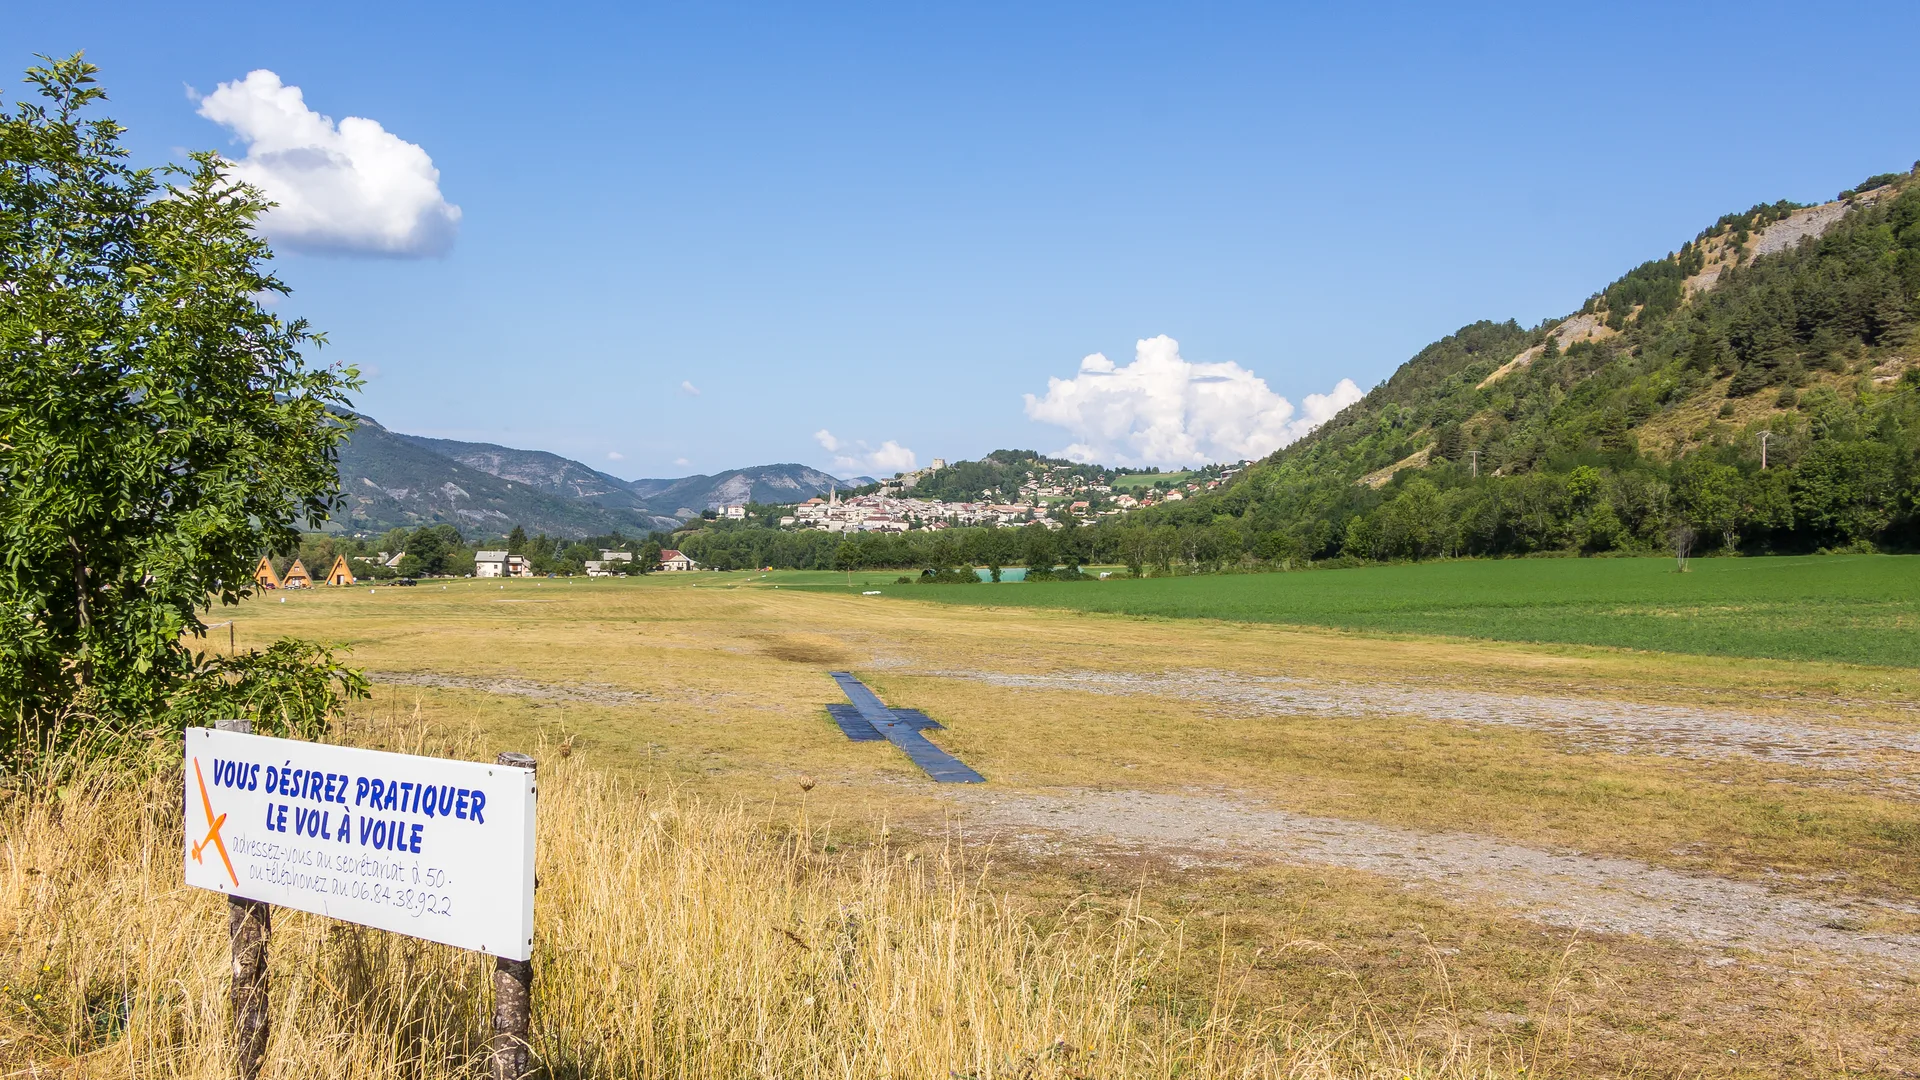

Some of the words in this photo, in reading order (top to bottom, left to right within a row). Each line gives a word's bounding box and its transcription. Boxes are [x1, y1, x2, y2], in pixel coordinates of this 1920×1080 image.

[214, 758, 260, 791] VOUS
[265, 760, 349, 804] DÉSIREZ
[355, 776, 486, 825] PRATIQUER
[266, 802, 288, 833] LE
[295, 806, 331, 840] VOL
[337, 805, 351, 844] À
[360, 815, 424, 854] VOILE
[232, 833, 313, 866] adressez-vous
[317, 851, 333, 869] au
[336, 853, 405, 882] secrétariat
[412, 860, 421, 885] à
[249, 864, 264, 881] ou
[266, 861, 328, 895] téléphonez
[332, 881, 348, 897] au
